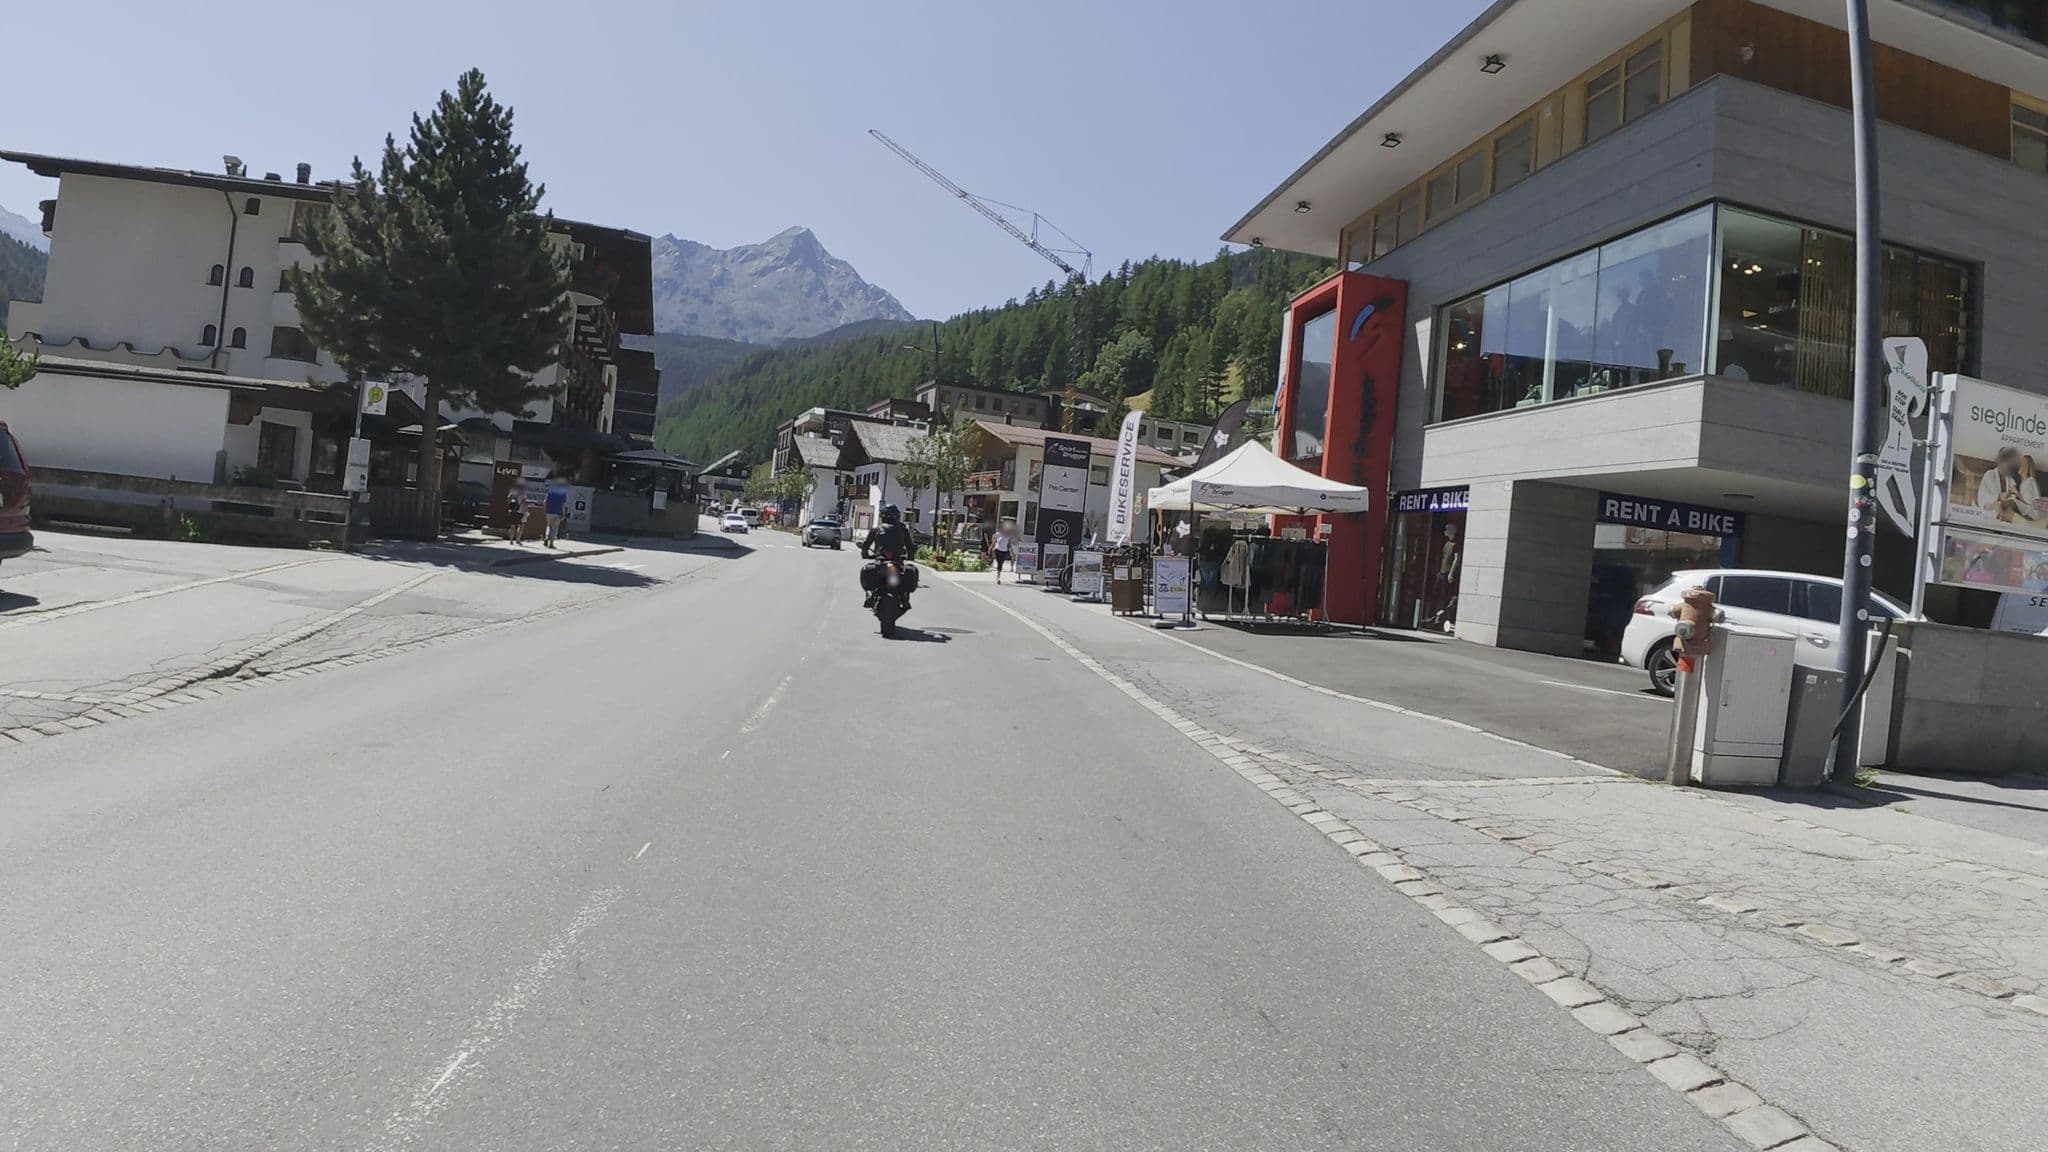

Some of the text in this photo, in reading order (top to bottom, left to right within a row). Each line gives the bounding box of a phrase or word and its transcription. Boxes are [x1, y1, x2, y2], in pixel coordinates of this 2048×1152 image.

[1971, 405, 2047, 436] sieglinde
[2001, 434, 2046, 450] APPARTEMENT
[1116, 420, 1135, 525] BIKESERVICE
[1399, 490, 1470, 511] RENT A BIKE
[1605, 499, 1735, 534] RENT A BIKE
